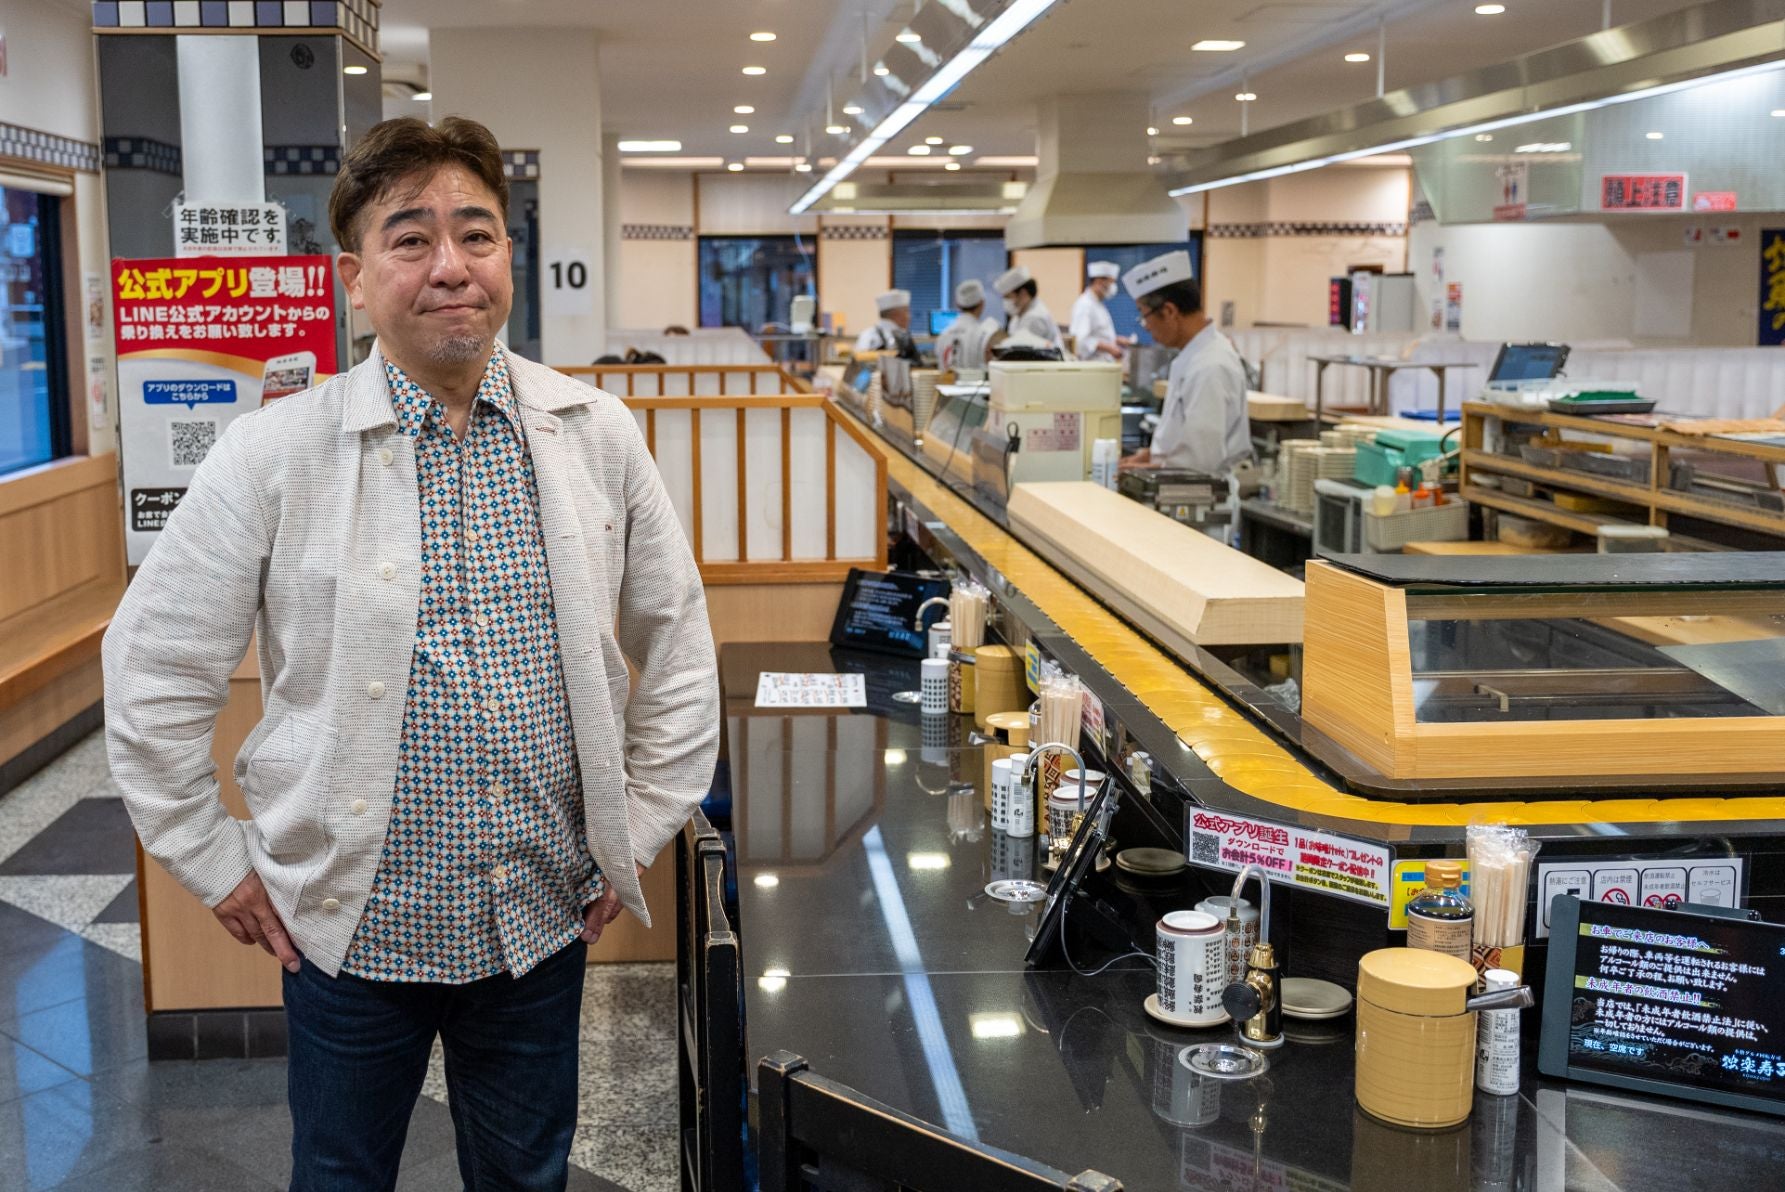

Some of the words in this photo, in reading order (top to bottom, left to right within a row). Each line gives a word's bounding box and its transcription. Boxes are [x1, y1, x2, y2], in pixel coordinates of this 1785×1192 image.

[180, 208, 279, 226] 年齢確認を
[180, 226, 282, 244] 実施中です。
[549, 261, 587, 290] 10
[119, 304, 331, 322] LINE公式アカウントからの
[120, 323, 306, 340] 乗り換えをお願い致します。
[147, 383, 231, 393] アプリのダウンロードは
[171, 392, 209, 401] こちらから
[1193, 813, 1289, 846] 公式アプリ誕生
[1227, 837, 1285, 856] ダウンロードで
[1601, 875, 1633, 884] 店内は禁煙
[1691, 879, 1731, 887] セルフサービス
[1591, 924, 1710, 950] お車でご来店のお客様へ
[1600, 955, 1738, 983] アルコール類のご提供は出来ません。
[1595, 1007, 1758, 1042] 未成年者の方にはアルコール類の提供は、
[1595, 1019, 1665, 1037] 一切しておりません。
